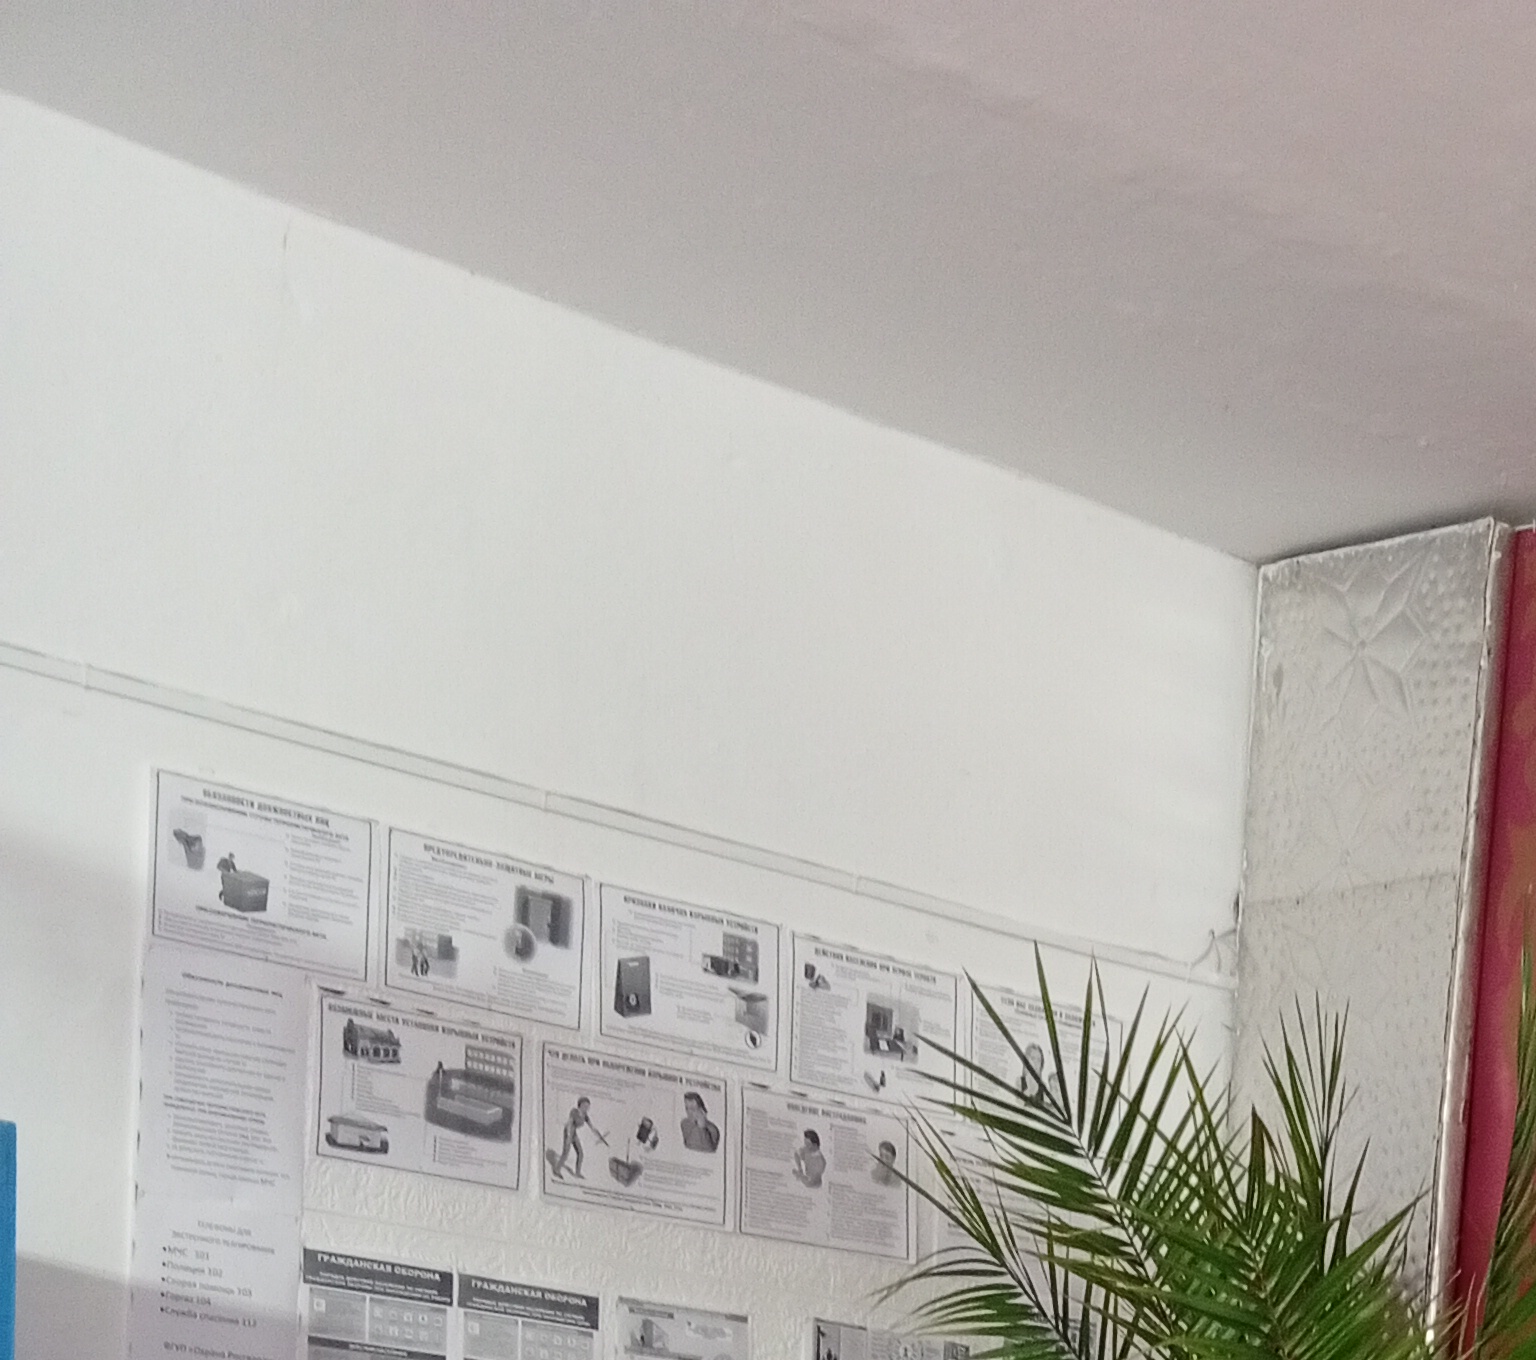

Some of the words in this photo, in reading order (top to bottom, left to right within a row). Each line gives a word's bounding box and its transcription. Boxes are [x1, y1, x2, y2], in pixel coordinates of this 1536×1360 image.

[317, 1253, 392, 1274] ГРАЖДАНСКАЯ
[394, 1265, 441, 1282] ОБОРОНА
[471, 1279, 542, 1299] ГРАЖДАНСКАЯ
[544, 1290, 587, 1307] ОБОРОНА
